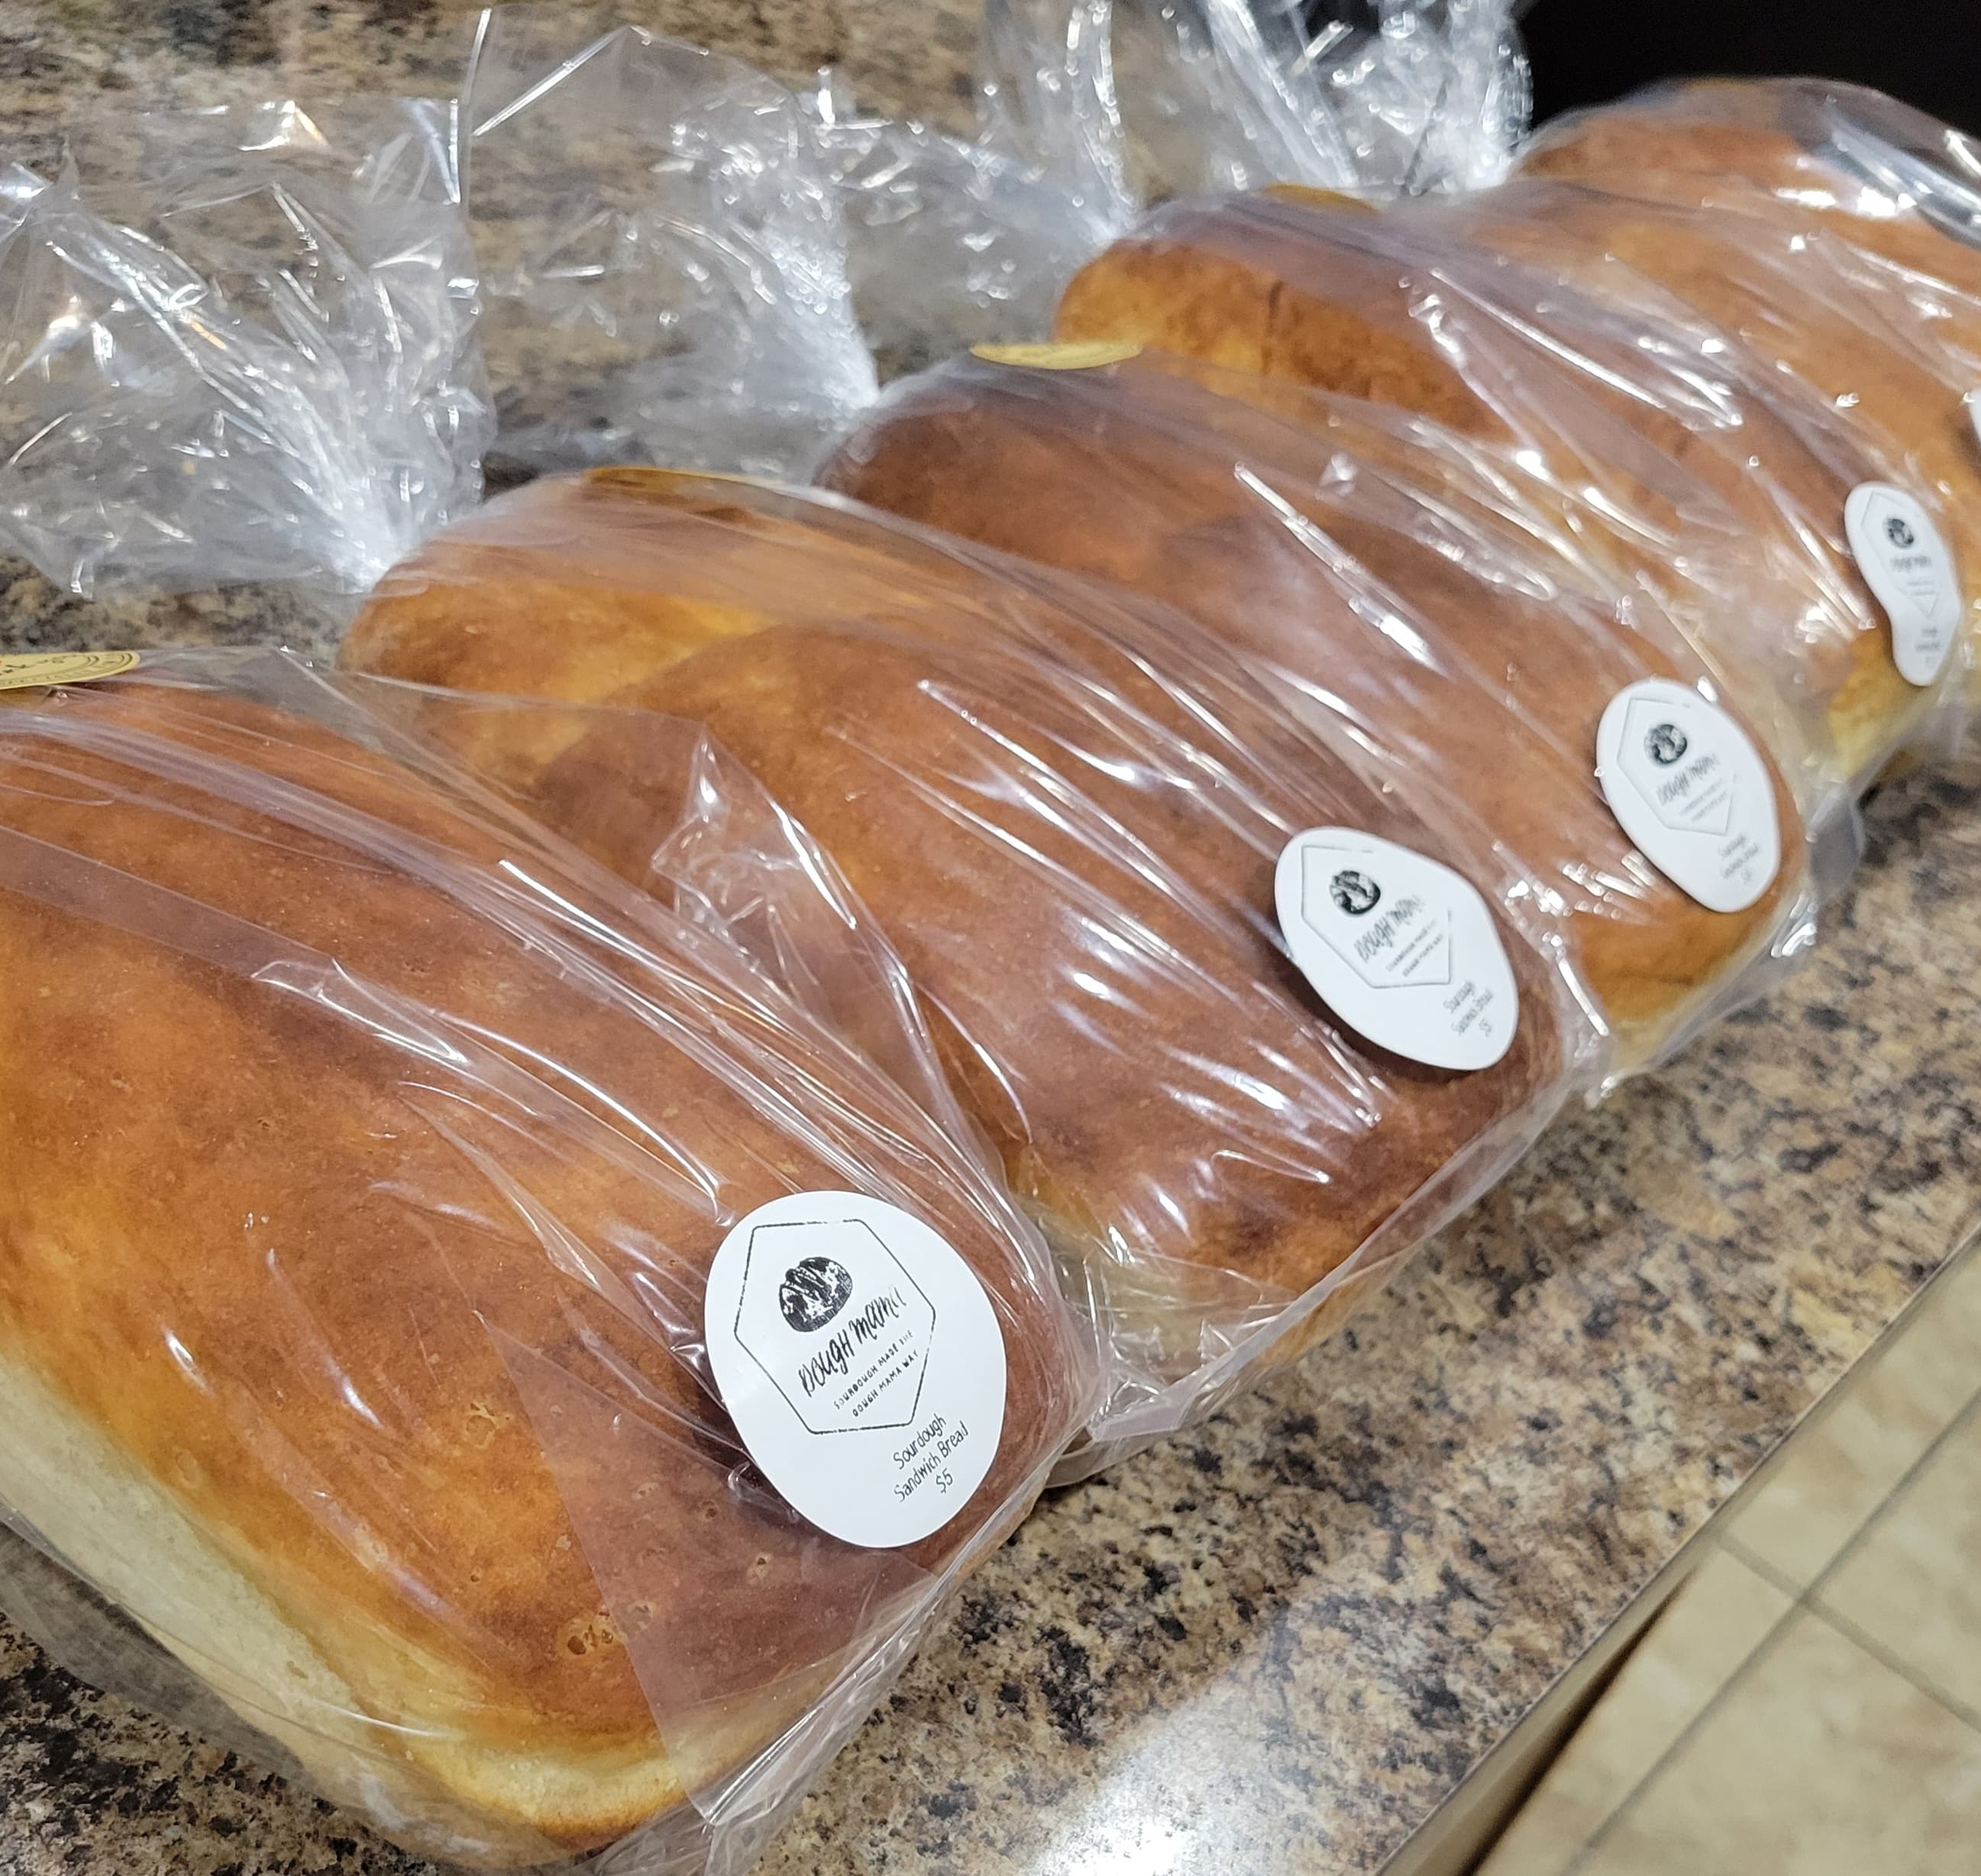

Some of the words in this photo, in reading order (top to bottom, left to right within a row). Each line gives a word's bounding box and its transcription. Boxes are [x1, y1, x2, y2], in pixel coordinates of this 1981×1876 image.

[833, 1364, 879, 1410] SOURDOUGH
[877, 1342, 899, 1367] MADE
[852, 1388, 879, 1418] DOUGH
[878, 1366, 903, 1392] MAMA
[901, 1348, 919, 1369] WAY
[893, 1412, 947, 1470] Sourdough
[894, 1451, 942, 1503] Sandwich
[936, 1419, 969, 1459] Bread
[936, 1467, 954, 1494] $5
